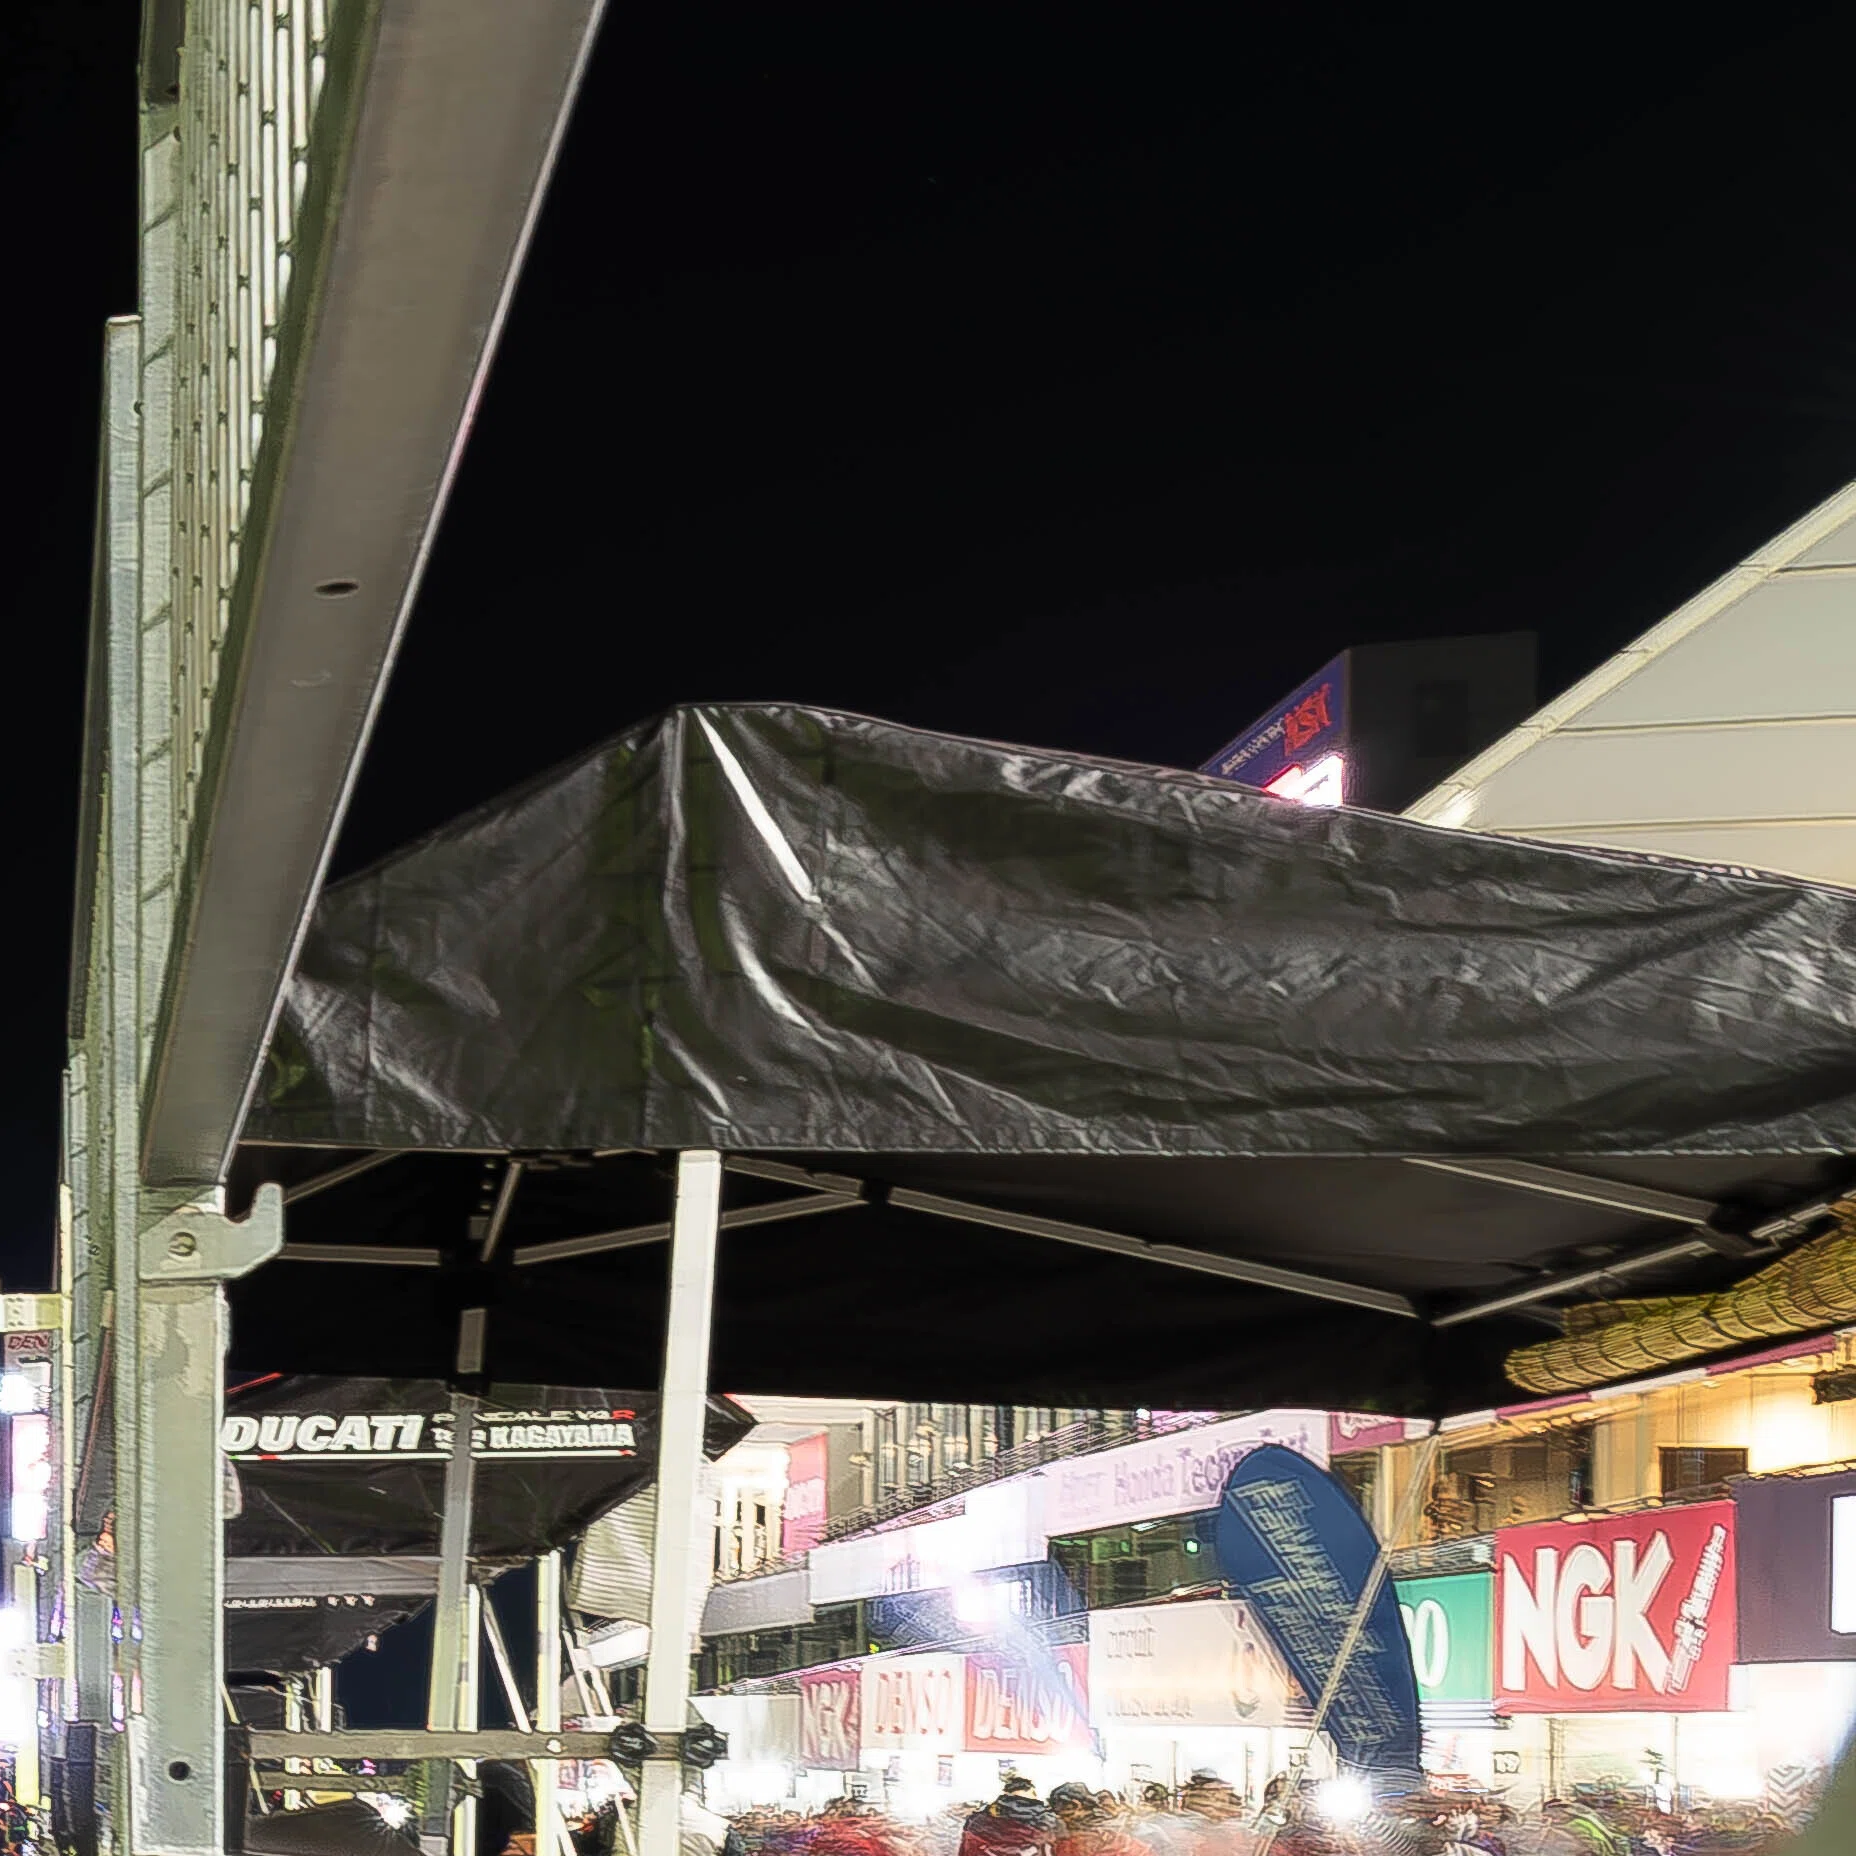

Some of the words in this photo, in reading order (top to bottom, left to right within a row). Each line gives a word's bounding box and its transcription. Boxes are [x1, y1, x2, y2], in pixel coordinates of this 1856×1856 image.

[222, 1414, 425, 1452] DUCATI
[489, 1424, 637, 1449] KAGAYAMA
[1501, 1529, 1675, 1696] NGK
